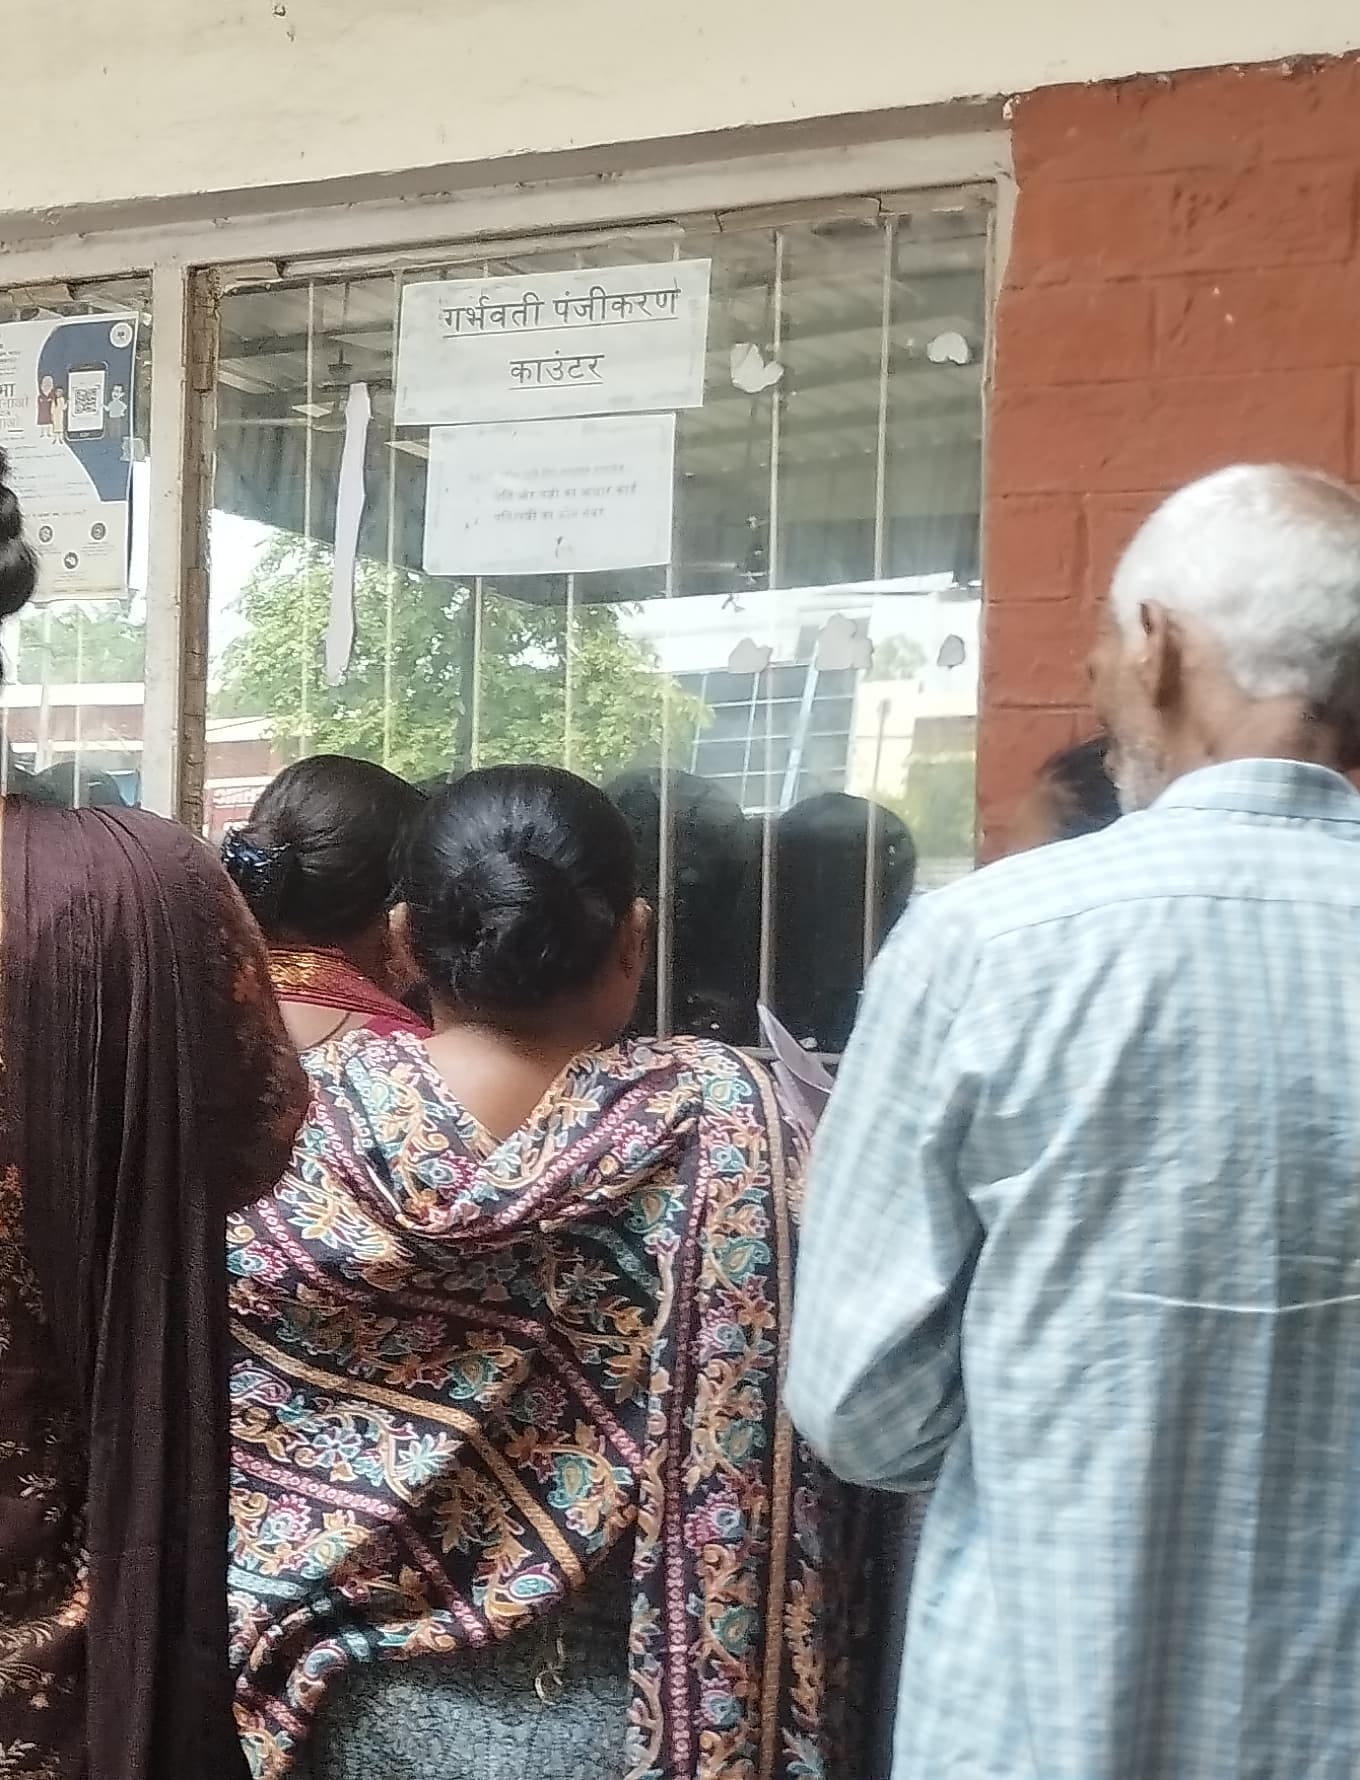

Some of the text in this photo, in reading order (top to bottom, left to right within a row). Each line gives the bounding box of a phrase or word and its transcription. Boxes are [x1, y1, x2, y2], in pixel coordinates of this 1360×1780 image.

[443, 285, 681, 332] गर्भवती पंजीकरण
[510, 350, 605, 384] काउंटर
